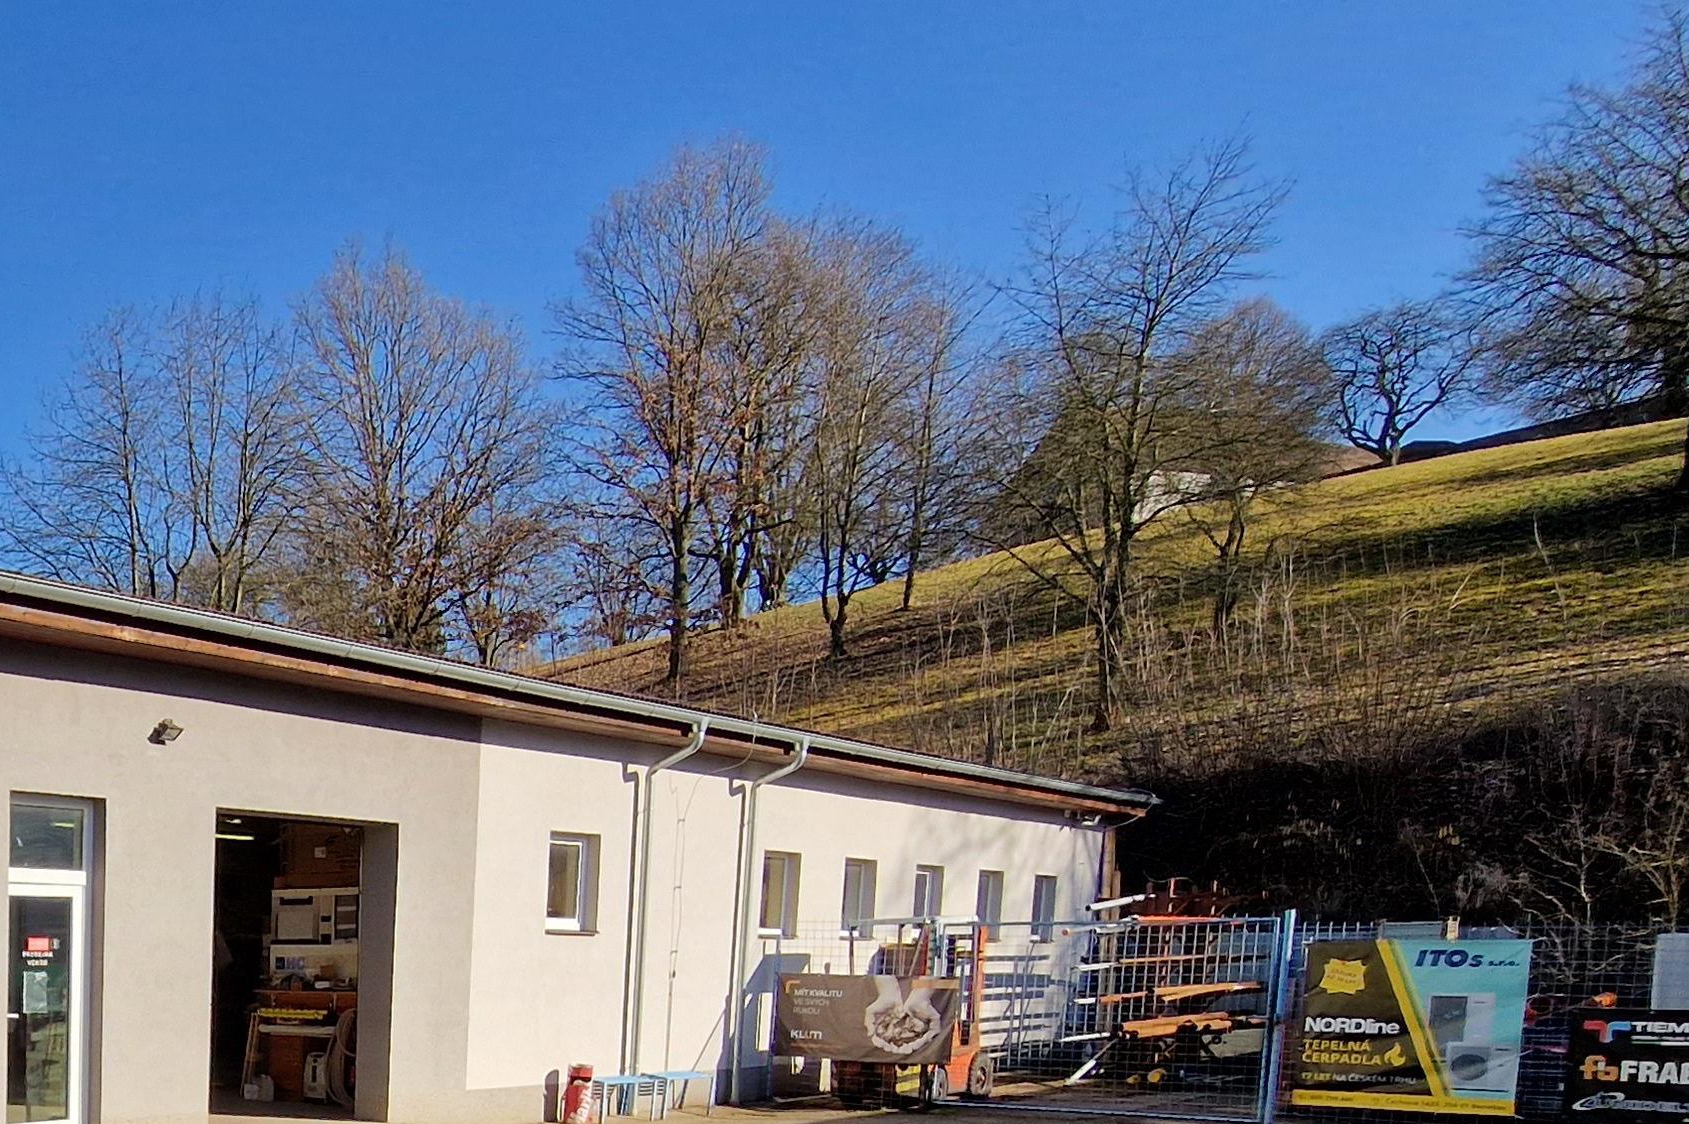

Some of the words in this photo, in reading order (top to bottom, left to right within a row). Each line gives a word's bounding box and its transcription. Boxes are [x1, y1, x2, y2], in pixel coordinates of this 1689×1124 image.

[1415, 949, 1483, 968] ITOs
[1303, 1038, 1372, 1052] TEPELNÁ
[1302, 1050, 1382, 1066] ČERPADLA
[1333, 1073, 1347, 1082] NA
